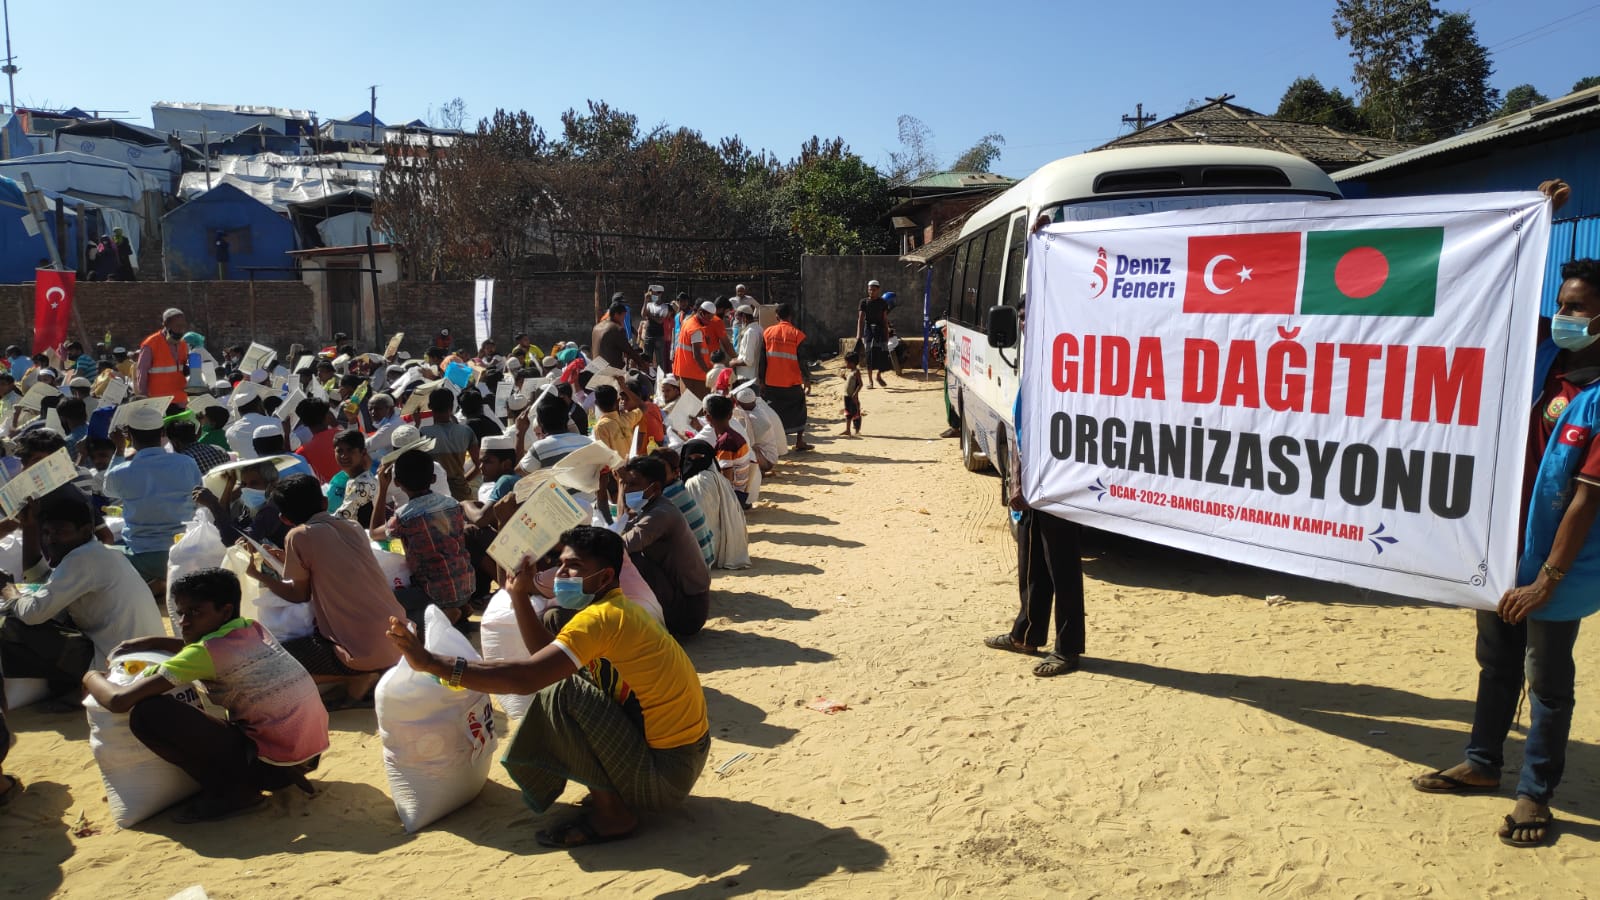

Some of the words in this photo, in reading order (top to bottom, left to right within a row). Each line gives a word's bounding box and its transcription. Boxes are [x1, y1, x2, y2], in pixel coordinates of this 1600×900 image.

[1111, 277, 1176, 298] Feneri
[1115, 254, 1171, 275] Deniz
[1051, 332, 1166, 401] GIDA
[1181, 326, 1485, 426] DAĞITIM
[1050, 411, 1475, 520] ORGANİZASYONU
[1109, 484, 1290, 529] OCAK-2022-BANGLADEŞ/ARAKAN
[1293, 516, 1364, 542] KAMPLARI
